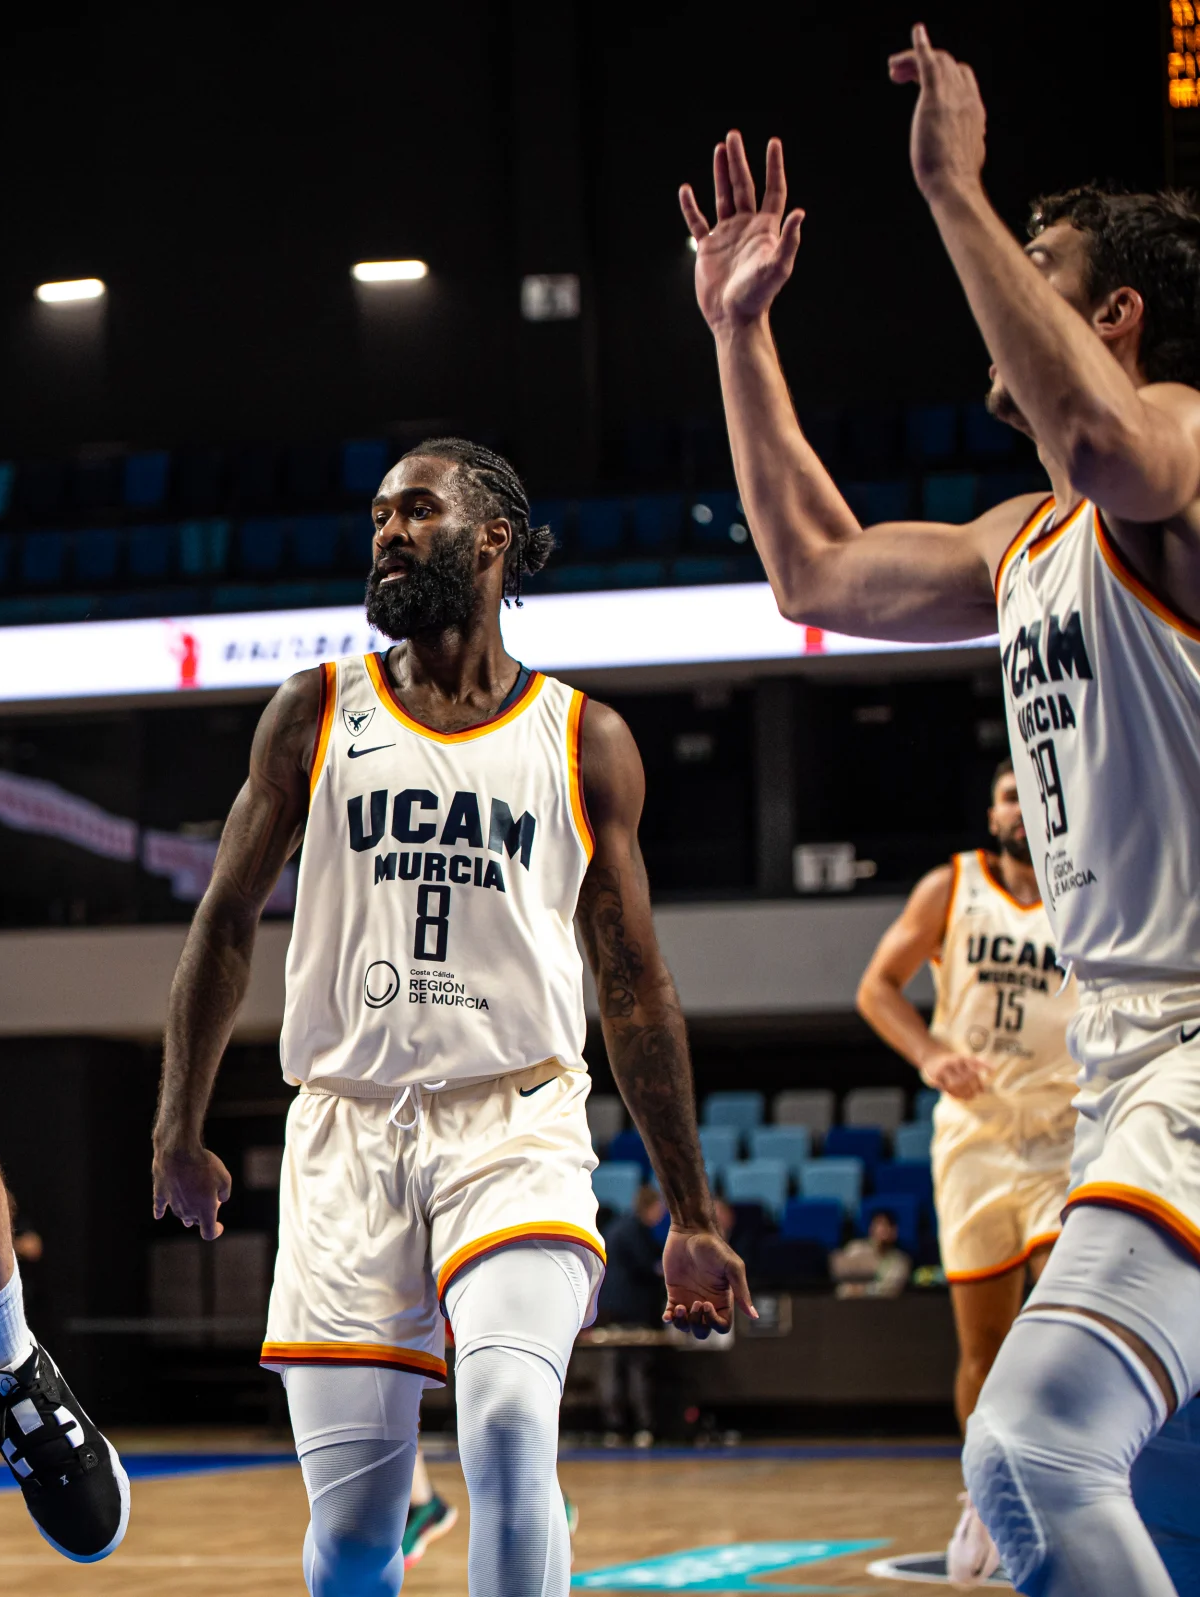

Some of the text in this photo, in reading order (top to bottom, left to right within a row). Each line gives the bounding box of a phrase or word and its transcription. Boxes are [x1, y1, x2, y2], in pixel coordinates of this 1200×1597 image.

[1018, 692, 1077, 743] URCIA
[347, 788, 537, 872] UCAM
[374, 852, 506, 893] MURCIA
[413, 884, 451, 963] 8
[409, 979, 465, 994] REGIÓN
[432, 970, 455, 979] Cálida
[409, 992, 489, 1010] DE MURCIA
[994, 985, 1024, 1032] 15
